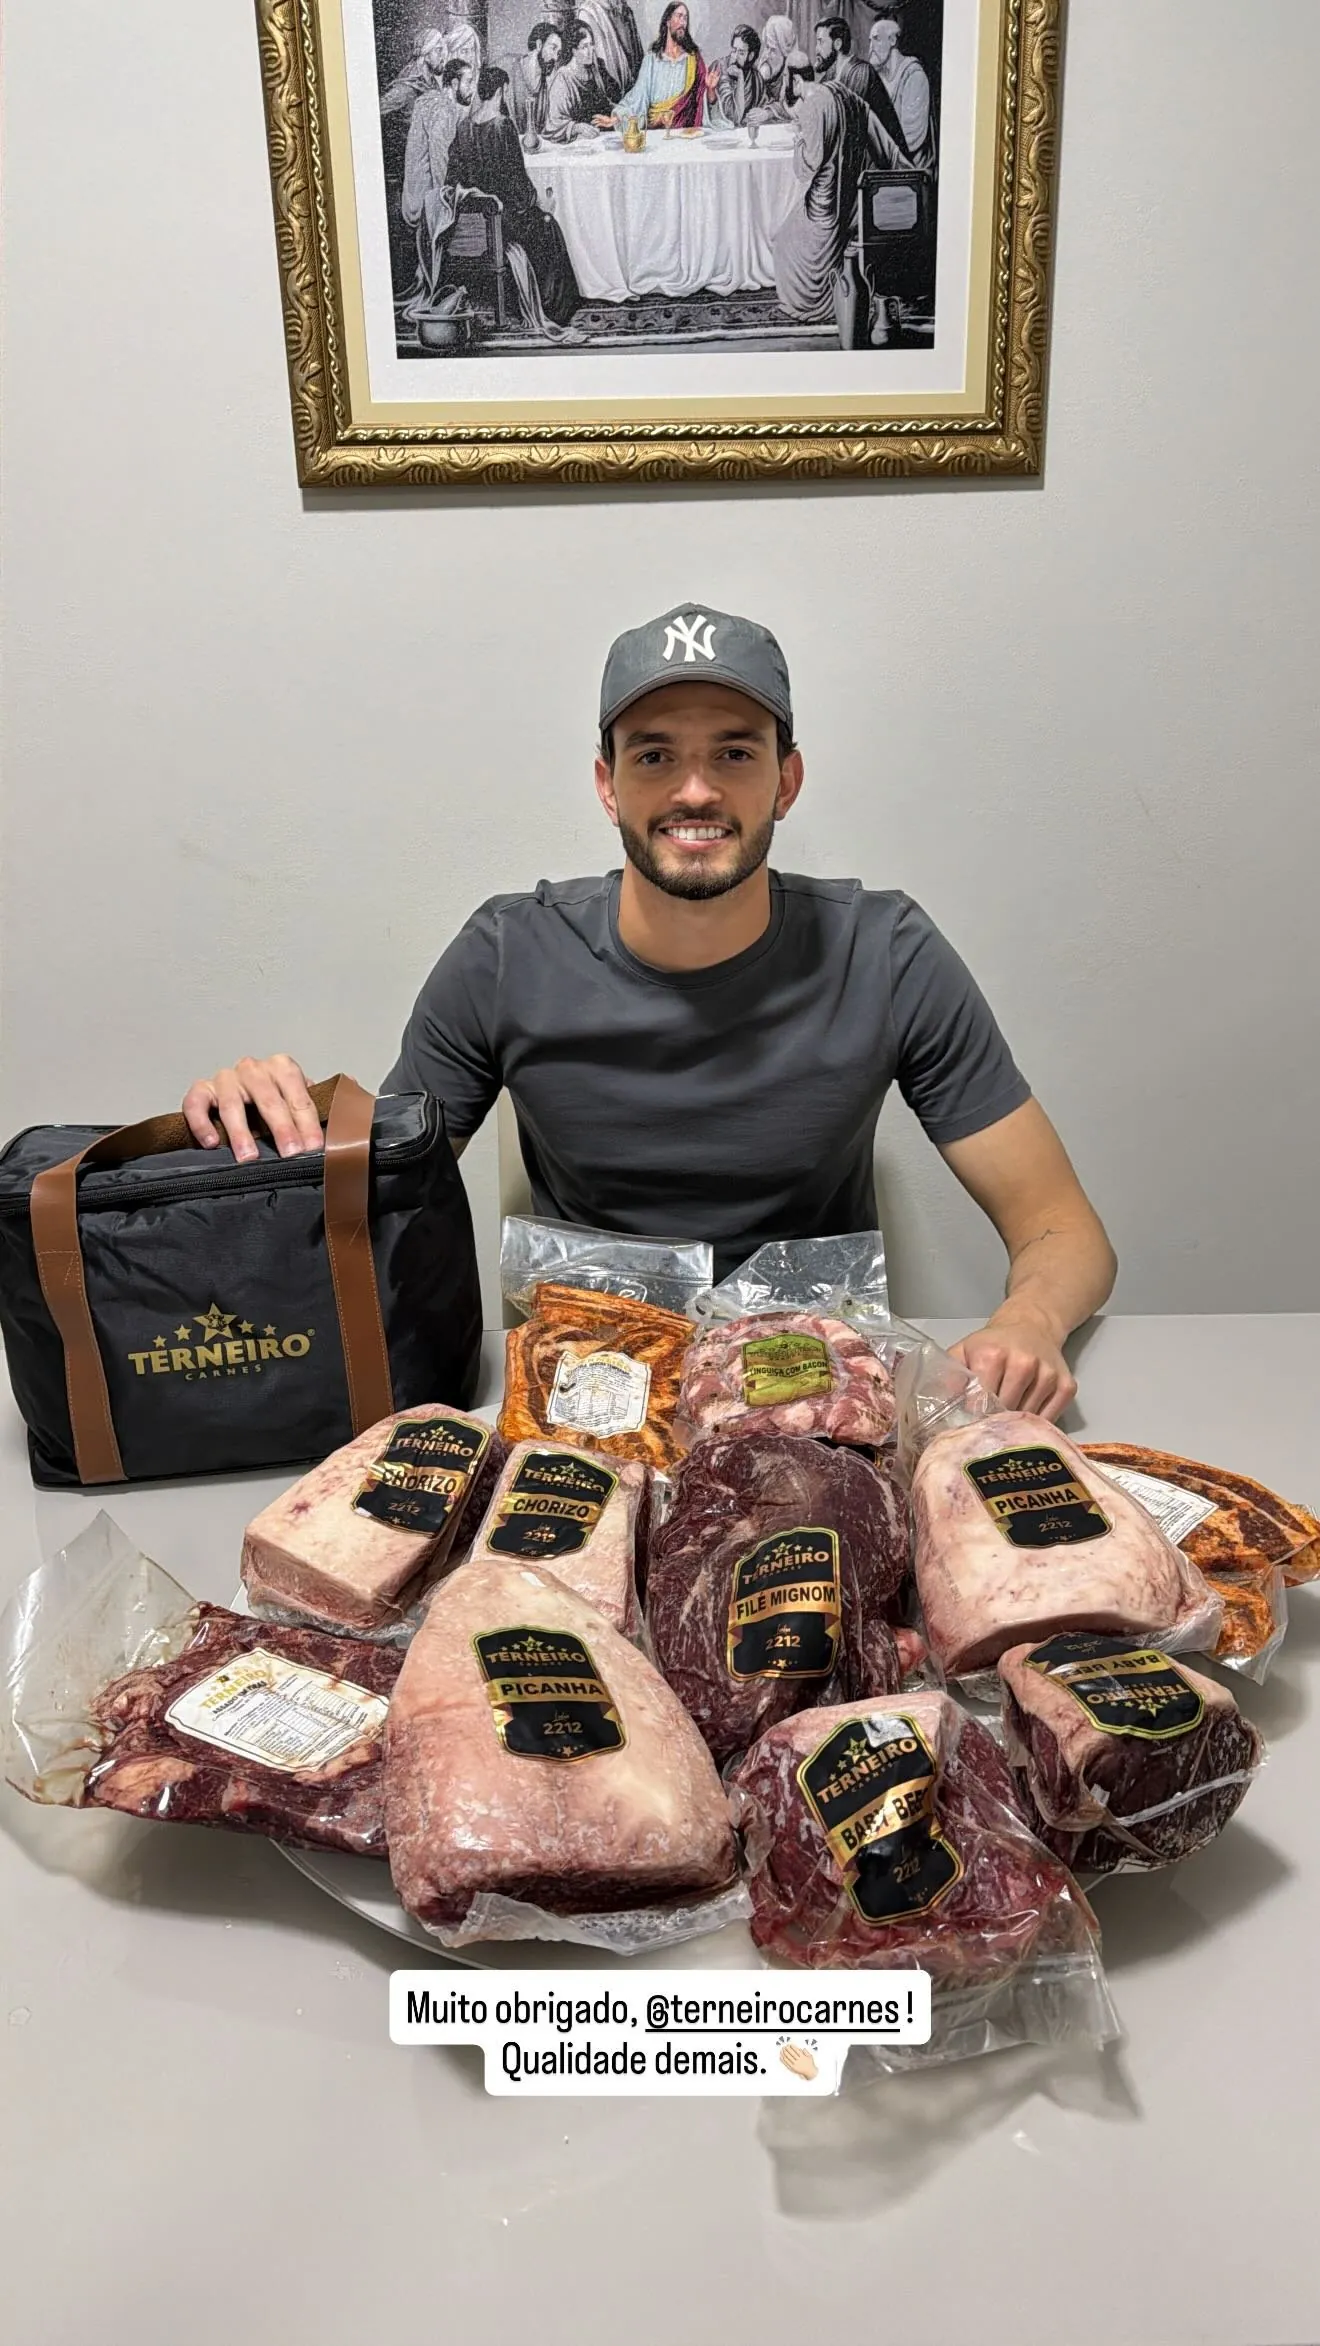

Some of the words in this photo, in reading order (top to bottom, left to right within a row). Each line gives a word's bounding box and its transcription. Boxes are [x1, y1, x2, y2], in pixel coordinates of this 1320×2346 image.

[662, 614, 716, 662] NY
[185, 1363, 262, 1381] CARNES
[785, 1366, 801, 1375] COM
[802, 1361, 828, 1370] BACON
[395, 1437, 474, 1457] TERNEIRO
[382, 1469, 457, 1493] CHORIZO
[976, 1462, 1063, 1484] TERNEIRO
[513, 1499, 590, 1518] CHORIZO
[995, 1488, 1079, 1514] PICANHA
[1039, 1520, 1073, 1533] 2212
[736, 1591, 767, 1620] FILÉ
[770, 1586, 836, 1607] MIGNOM
[766, 1635, 801, 1651] 2212
[486, 1650, 586, 1663] TERNEIRO
[1113, 1654, 1160, 1669] BABY
[201, 1669, 268, 1709] TERNEIRO
[500, 1682, 604, 1696] PICANHA
[1086, 1683, 1190, 1704] TERNEIRO
[543, 1721, 583, 1735] 2212
[816, 1739, 918, 1804] TERNEIRO
[893, 1856, 920, 1883] 2212
